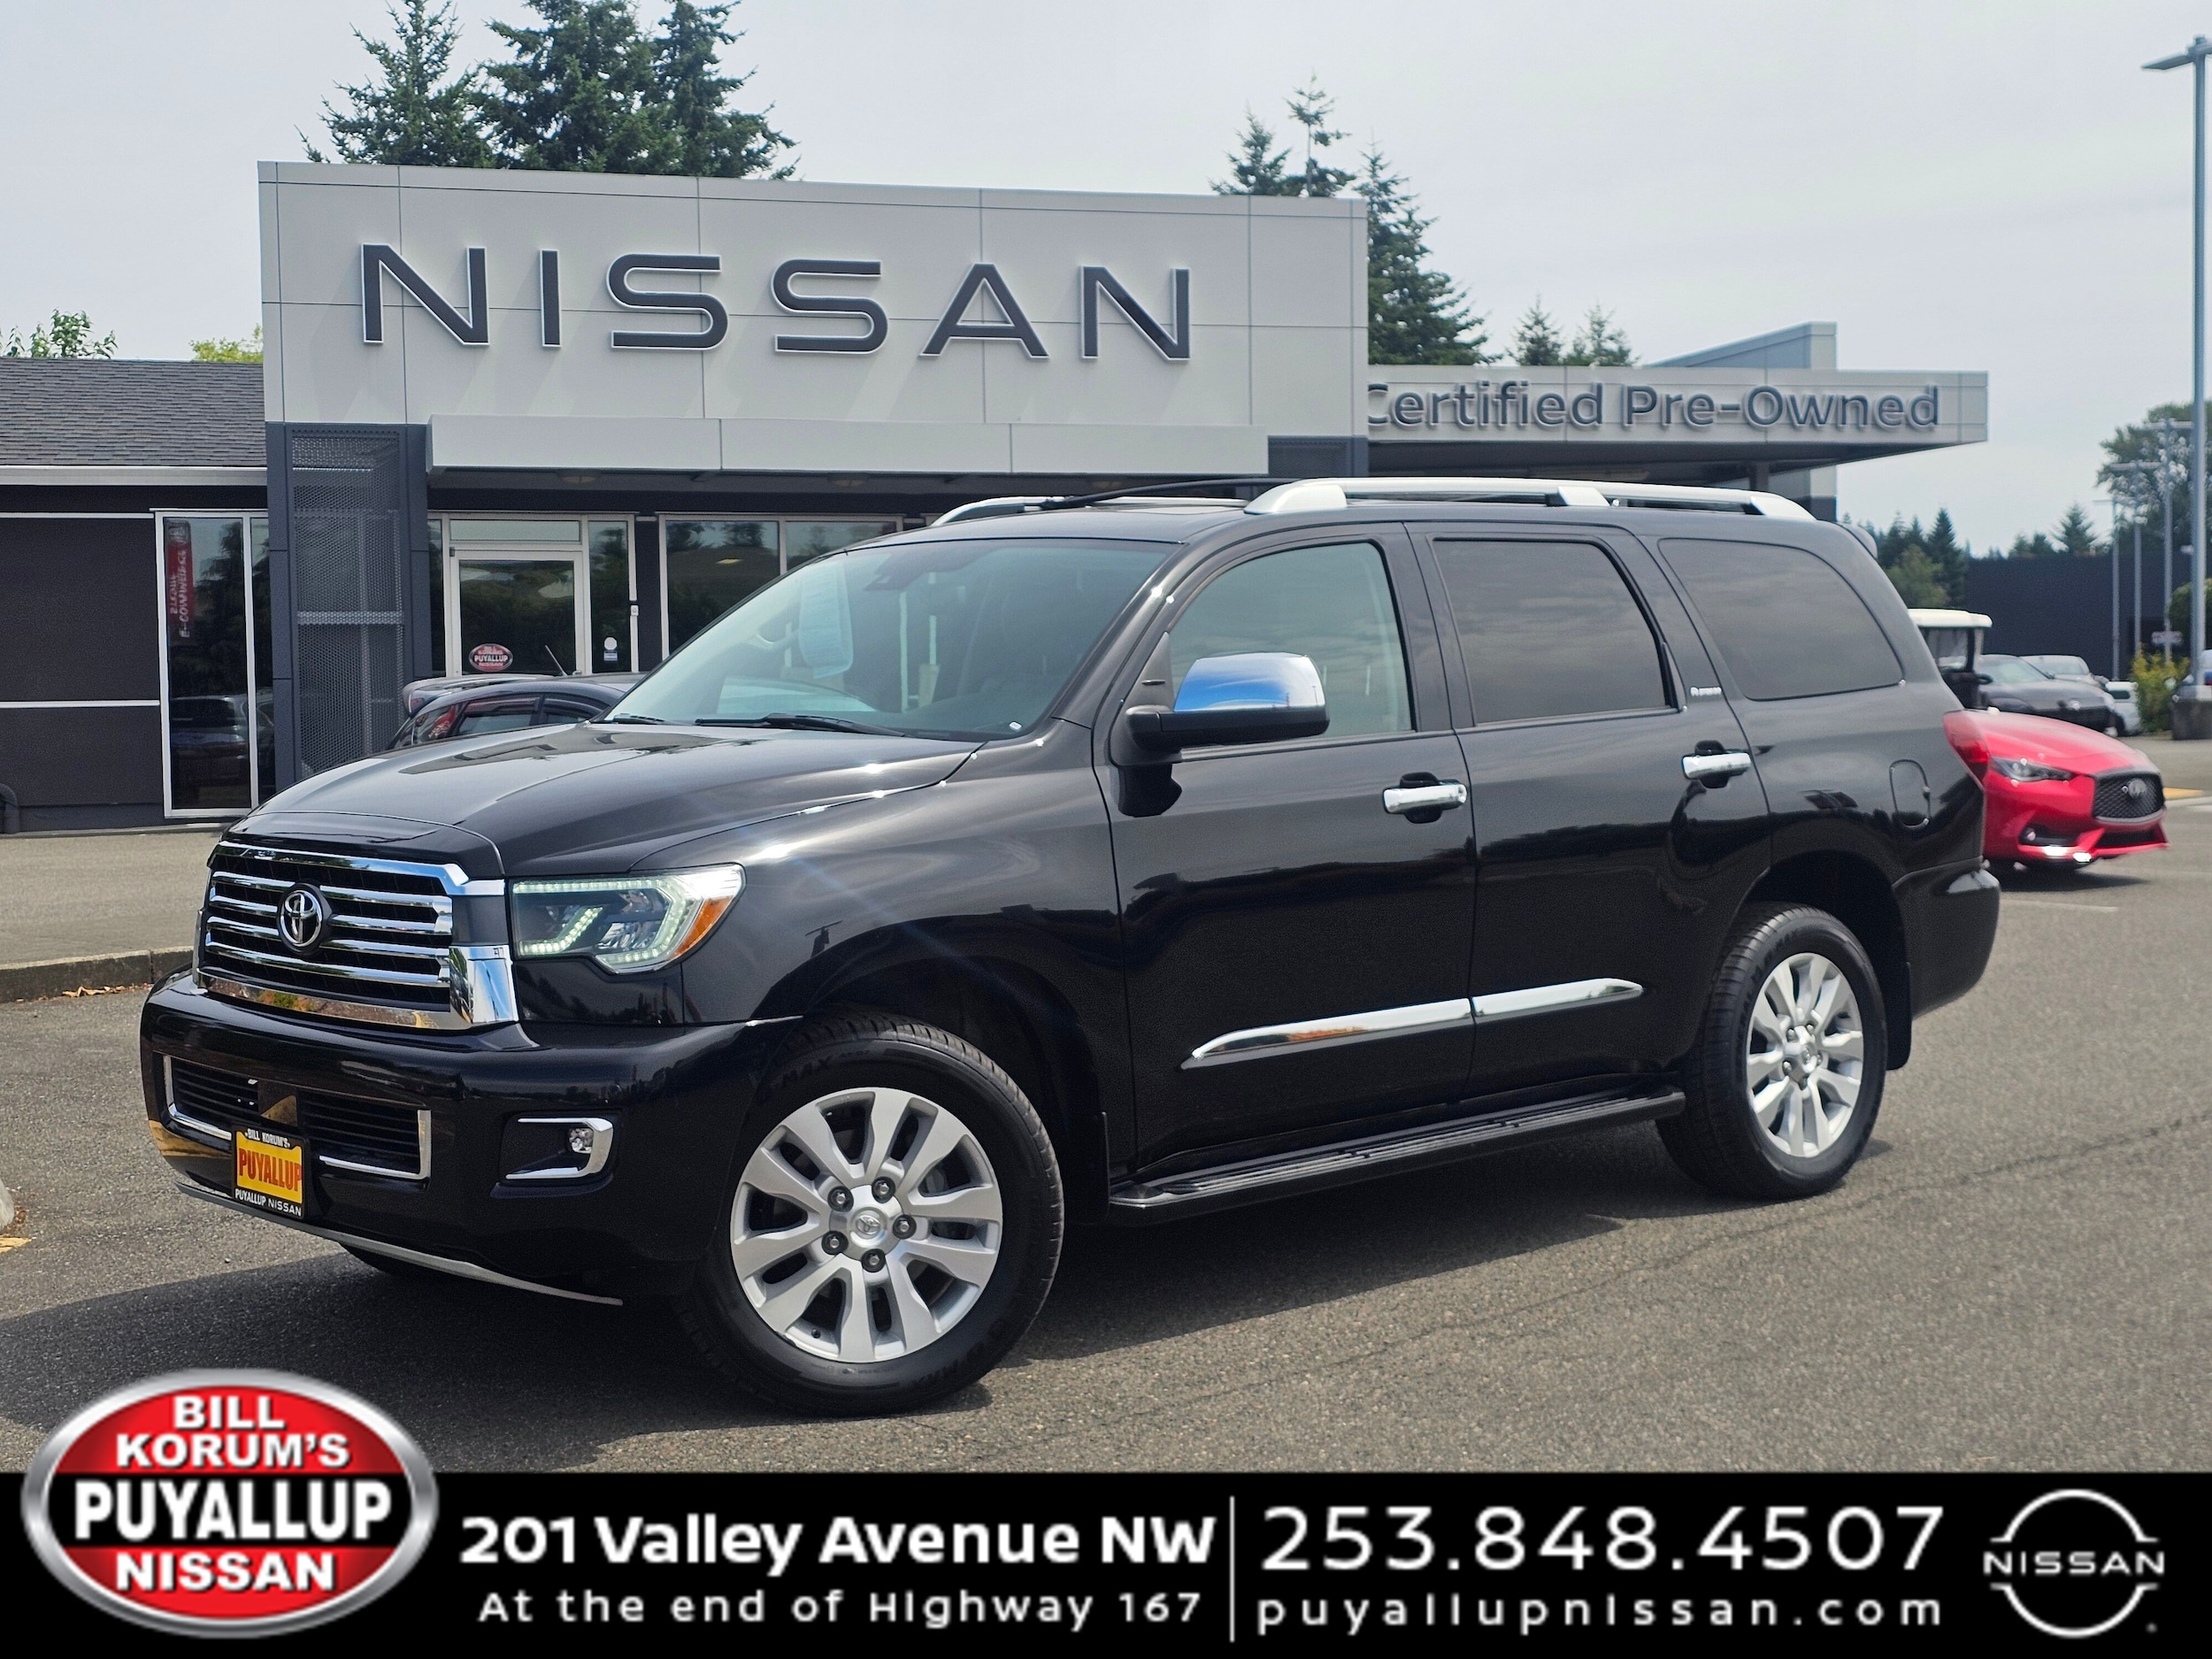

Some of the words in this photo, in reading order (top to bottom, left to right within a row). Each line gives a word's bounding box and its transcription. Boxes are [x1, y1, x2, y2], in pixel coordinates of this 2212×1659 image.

[360, 242, 1192, 361] NISSAN
[1624, 384, 1939, 427] Pre-Owned
[238, 1148, 302, 1192] PUYALLUP
[234, 1188, 266, 1206] PUYALLUP
[268, 1198, 302, 1217] NISSAN
